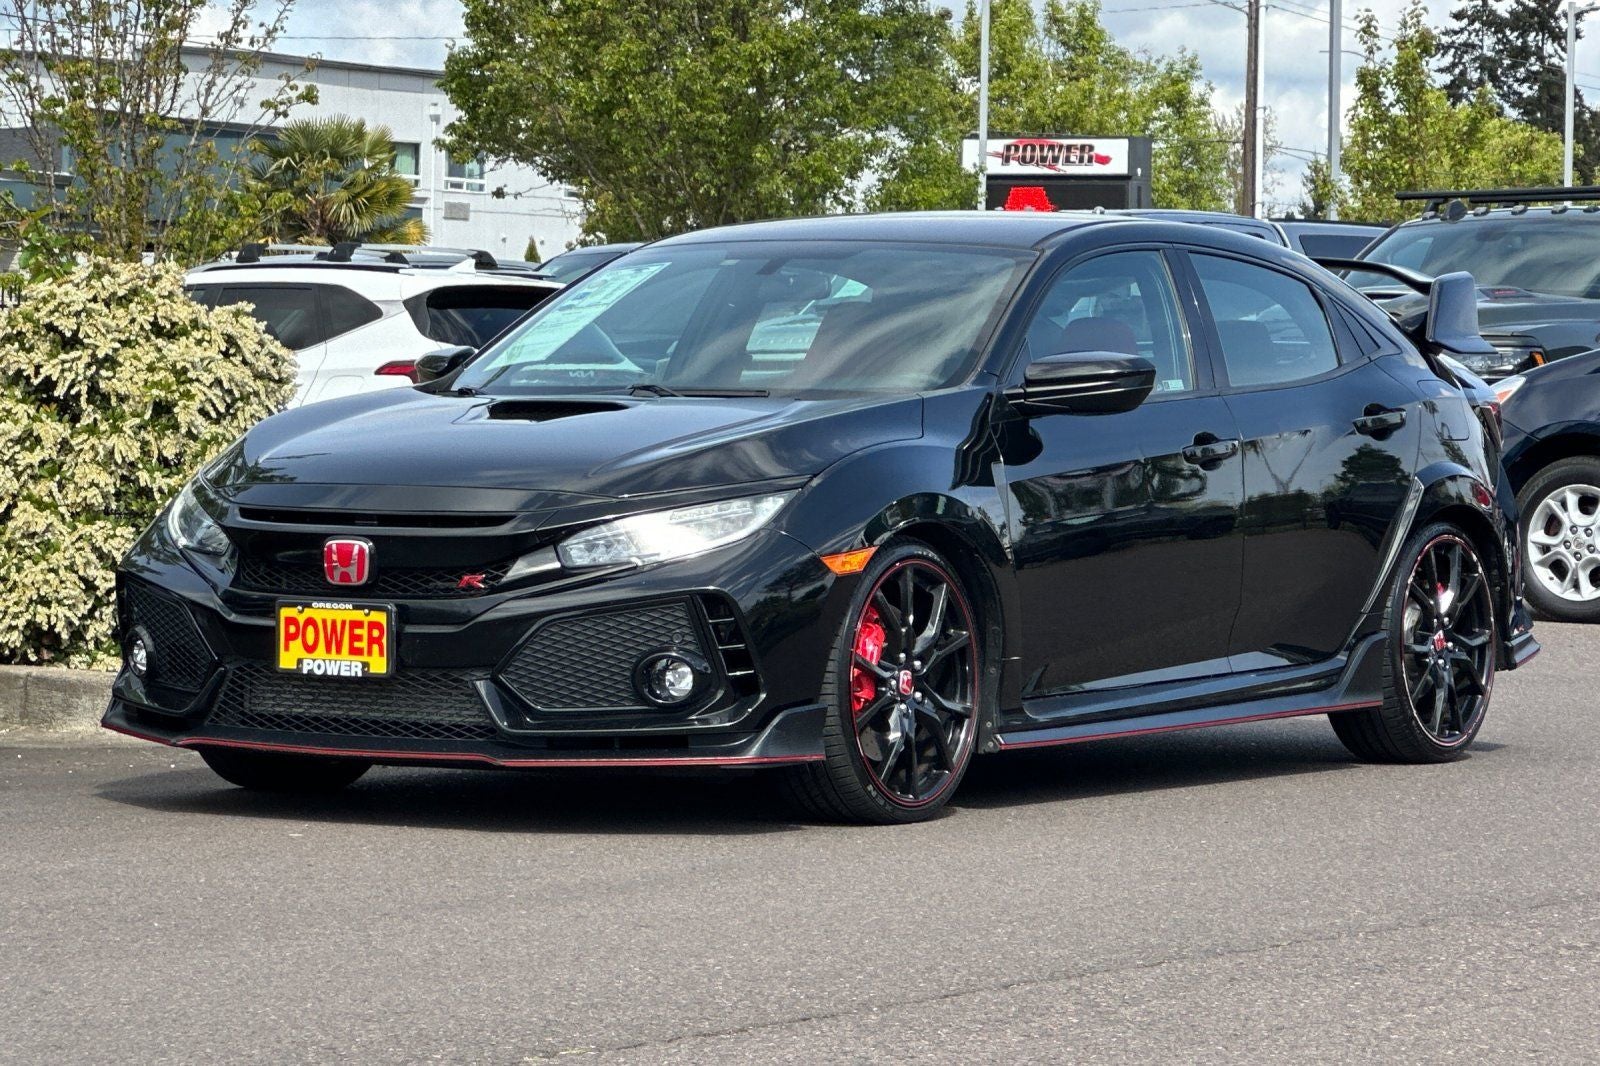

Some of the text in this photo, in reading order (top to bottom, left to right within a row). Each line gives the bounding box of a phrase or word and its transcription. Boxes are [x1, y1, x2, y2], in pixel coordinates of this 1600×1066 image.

[1001, 143, 1096, 167] POWER
[311, 602, 353, 610] OREGON
[284, 616, 385, 658] POWER
[302, 659, 363, 677] POWER
